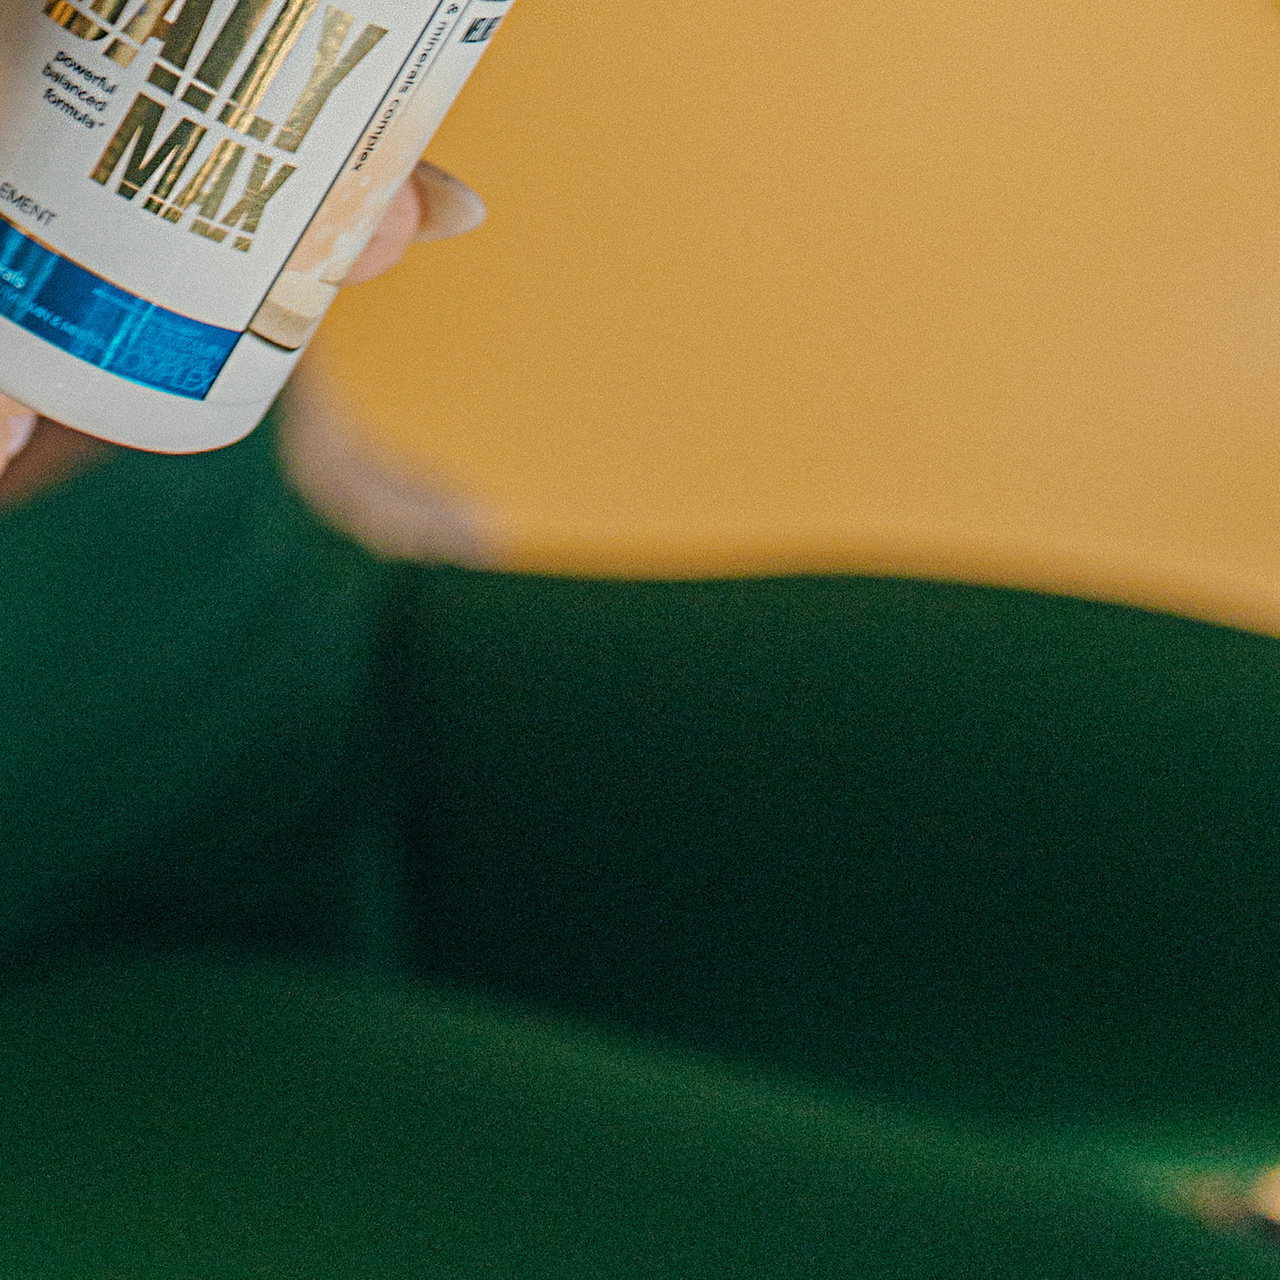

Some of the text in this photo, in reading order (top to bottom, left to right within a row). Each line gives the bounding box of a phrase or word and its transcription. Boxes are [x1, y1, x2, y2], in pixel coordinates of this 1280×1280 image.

[445, 3, 460, 16] &
[42, 62, 108, 112] balanced
[53, 51, 117, 95] powerful
[399, 20, 448, 95] minerals
[353, 98, 400, 172] complex
[89, 92, 298, 252] MAX
